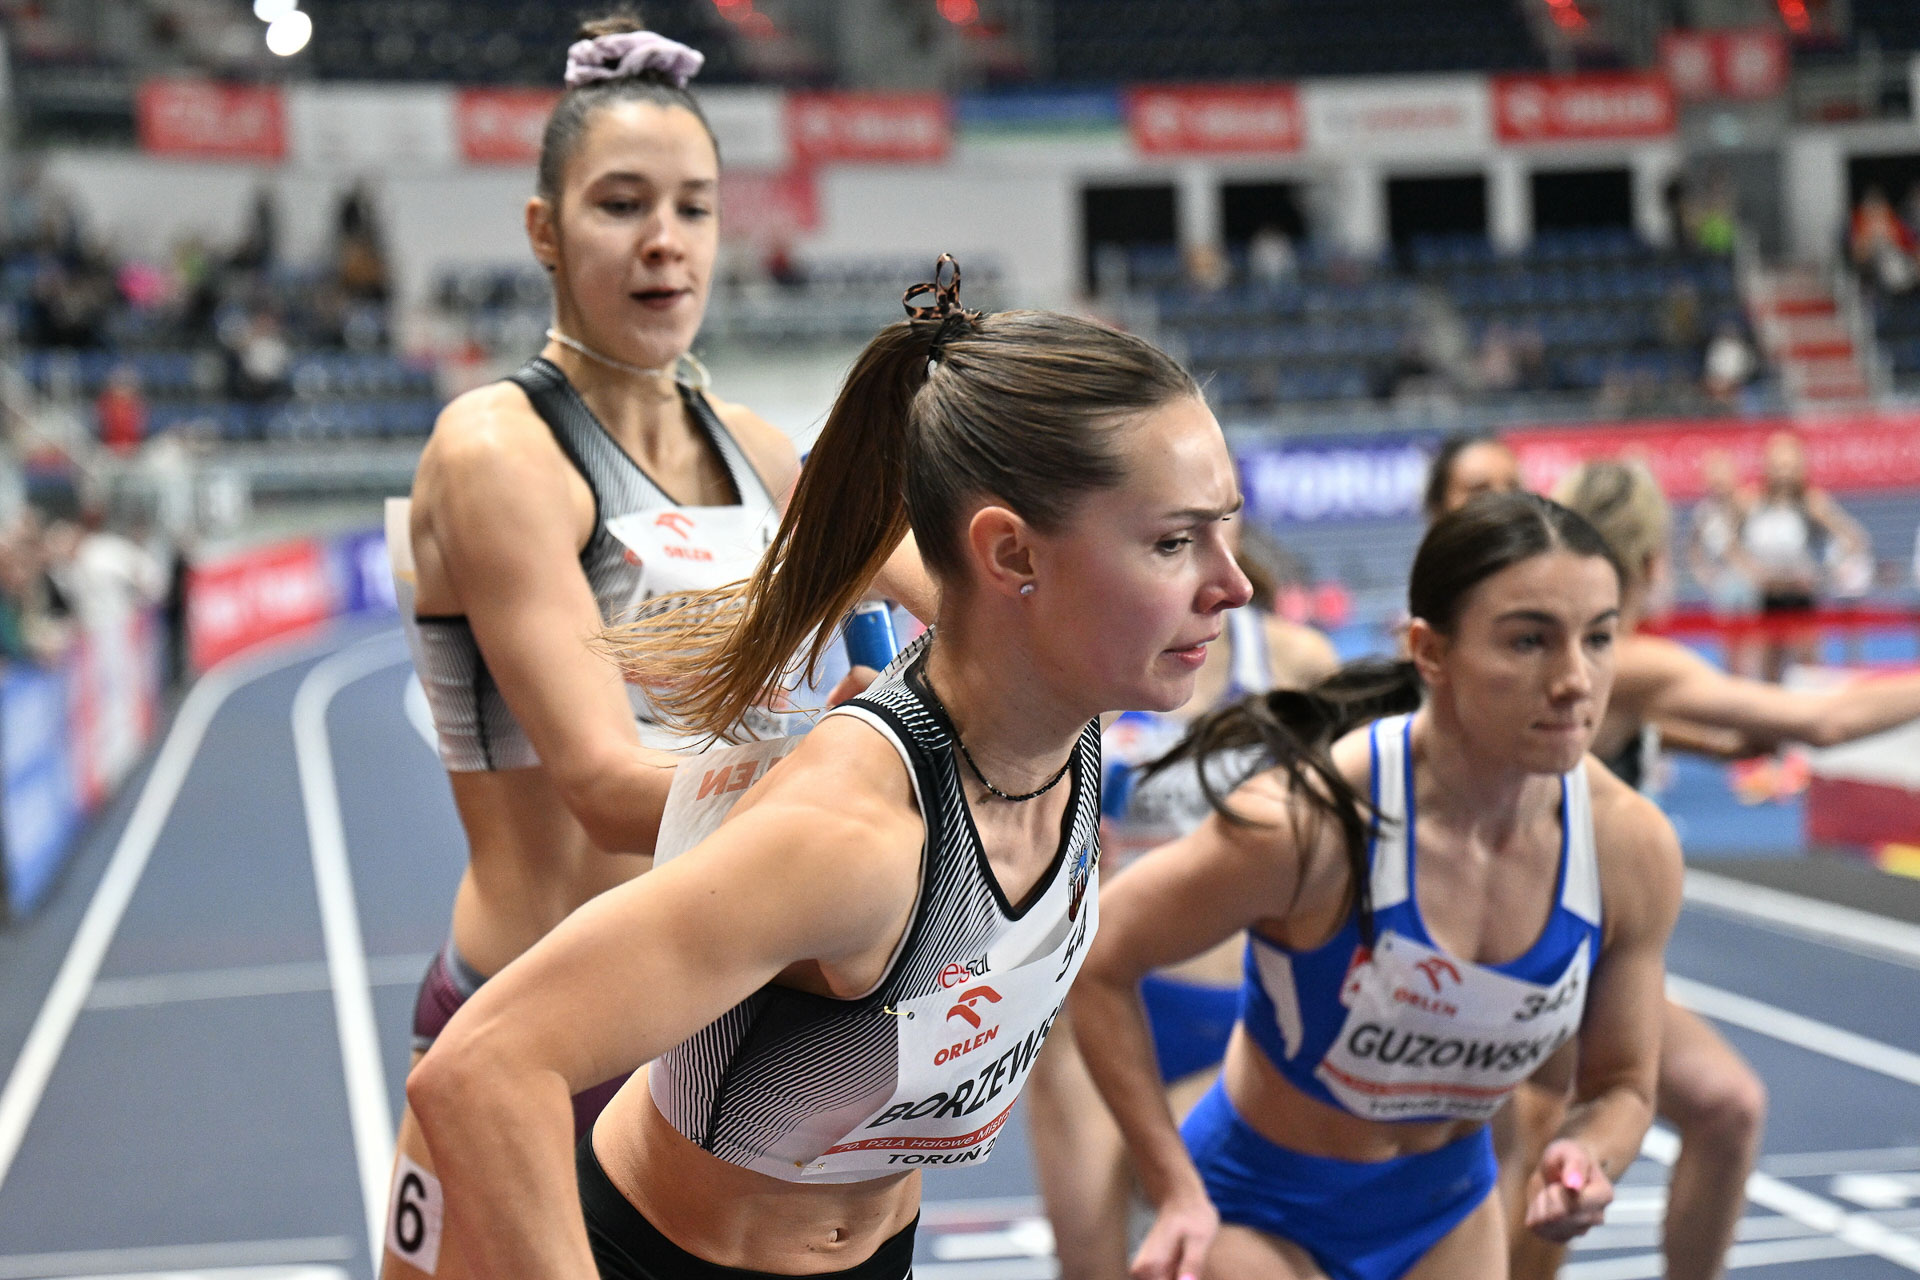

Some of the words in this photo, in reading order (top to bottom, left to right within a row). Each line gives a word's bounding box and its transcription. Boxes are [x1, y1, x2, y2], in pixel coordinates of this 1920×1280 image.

[1393, 987, 1458, 1017] ORLEN
[934, 1025, 1000, 1066] ORLEN
[865, 998, 1063, 1129] BORZEWS
[866, 1139, 906, 1148] PZLA
[910, 1136, 975, 1148] Halowe
[888, 1145, 982, 1164] TORUŃ
[396, 1172, 426, 1254] 6
